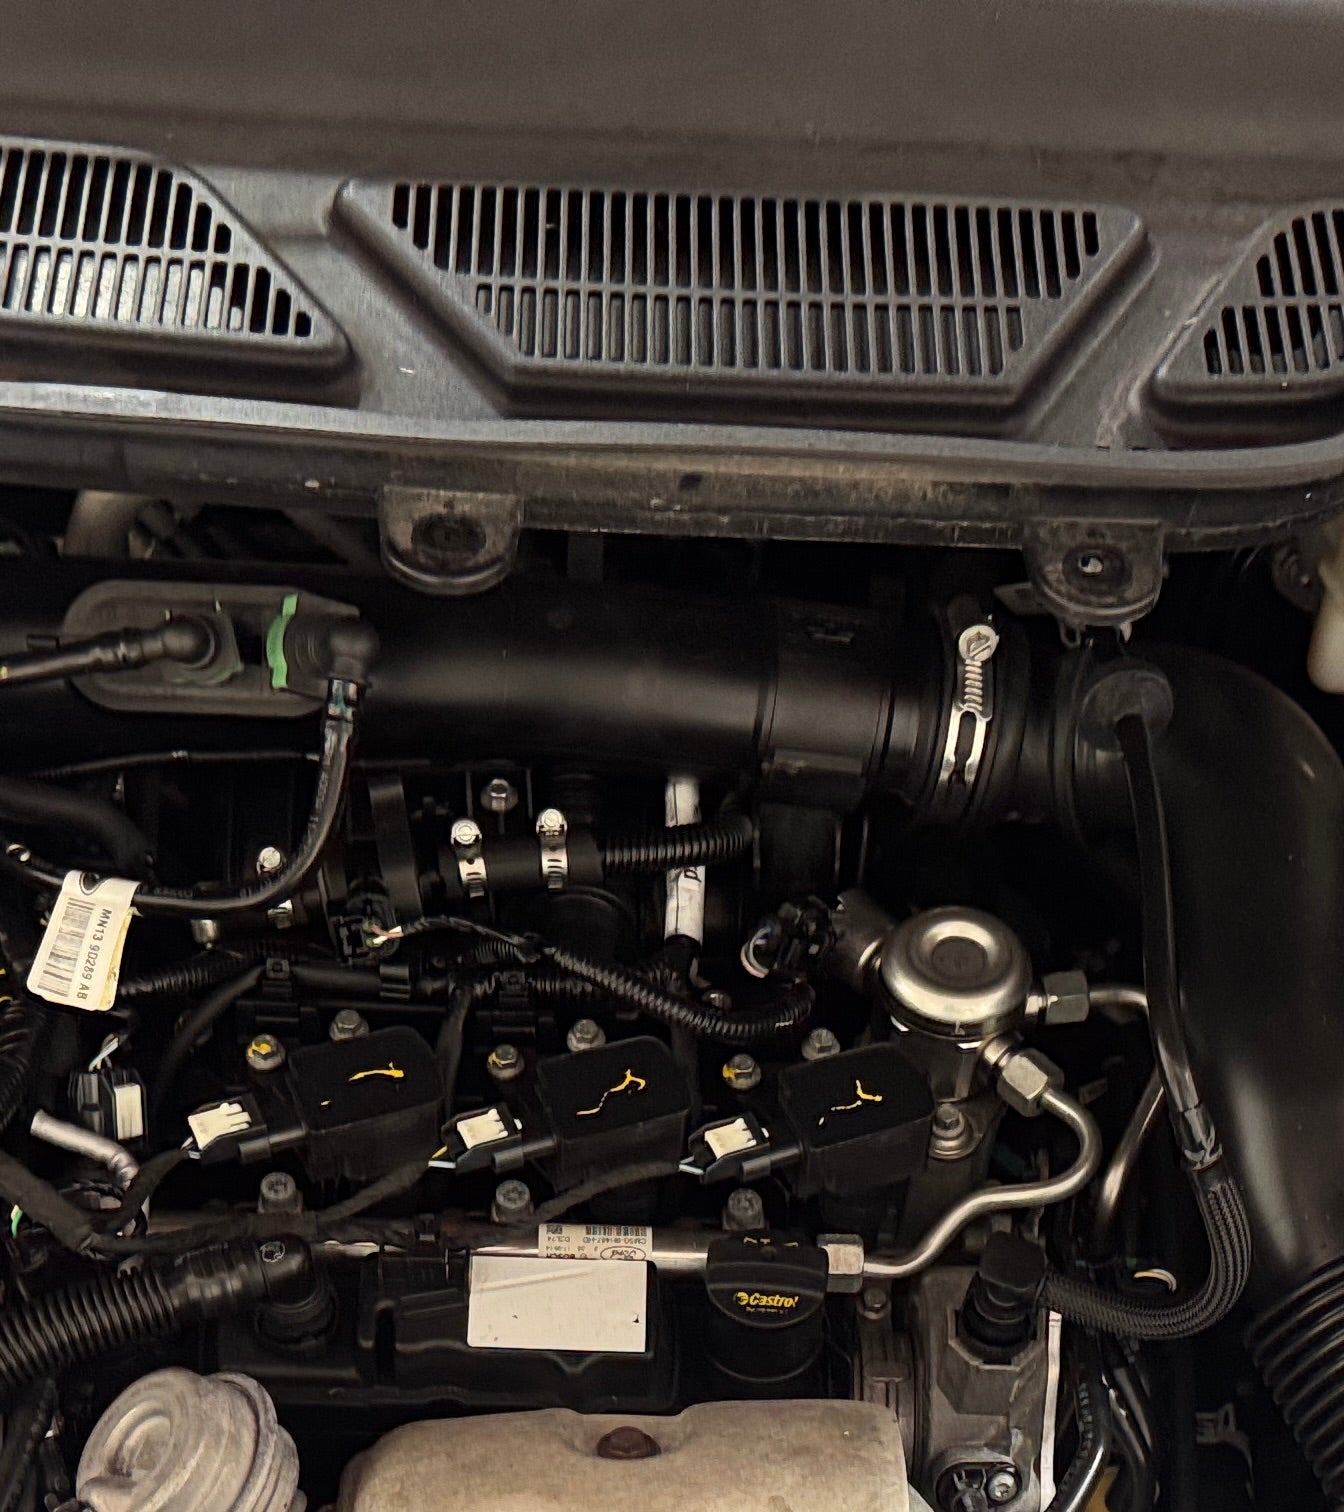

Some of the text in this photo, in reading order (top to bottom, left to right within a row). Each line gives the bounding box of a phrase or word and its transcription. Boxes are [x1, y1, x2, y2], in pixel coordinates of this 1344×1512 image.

[76, 908, 113, 1000] MN13 9D289 AB
